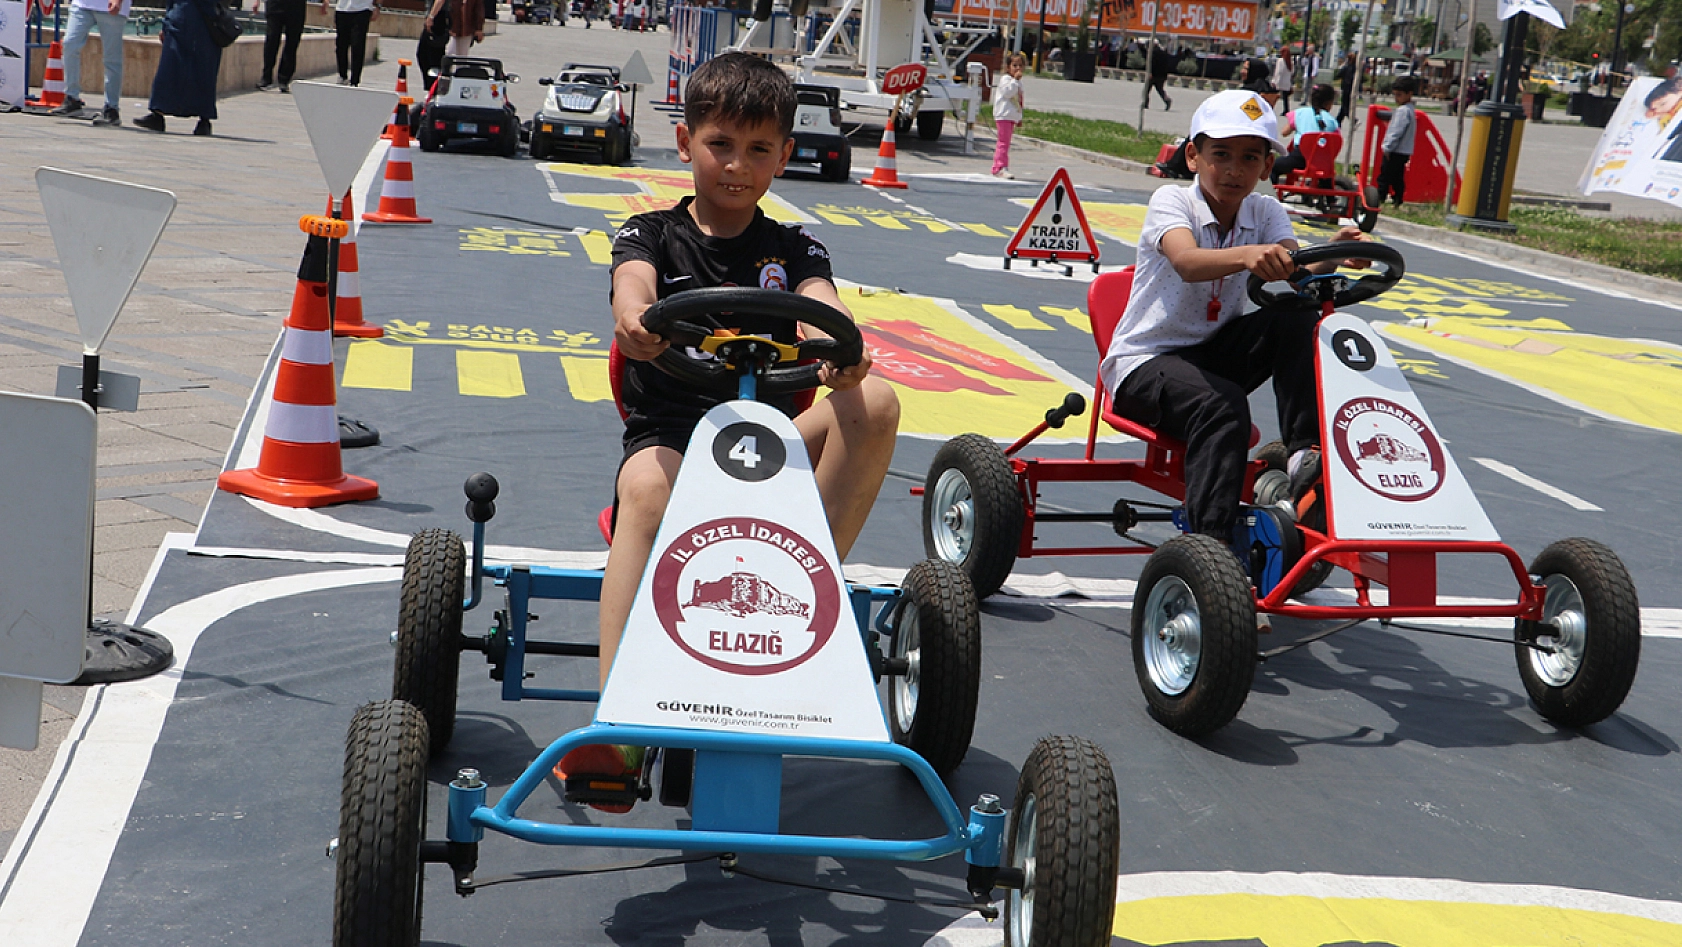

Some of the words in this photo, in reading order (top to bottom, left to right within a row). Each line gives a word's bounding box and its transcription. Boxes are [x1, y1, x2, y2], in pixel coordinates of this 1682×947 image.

[888, 70, 921, 88] DUR
[1031, 225, 1080, 238] TRAFİK
[1028, 238, 1080, 250] KAZASI
[1343, 338, 1367, 362] 1
[728, 435, 761, 468] 4
[1377, 471, 1424, 488] ELAZIĞ
[670, 548, 693, 564] İL
[691, 525, 743, 547] ÖZEL
[750, 523, 824, 574] İDARESİ
[709, 629, 783, 656] ELAZIĞ
[656, 700, 733, 716] GÜVENİR
[735, 707, 757, 718] Özel
[758, 710, 795, 722] Tasarım
[797, 713, 833, 724] Bisiklet
